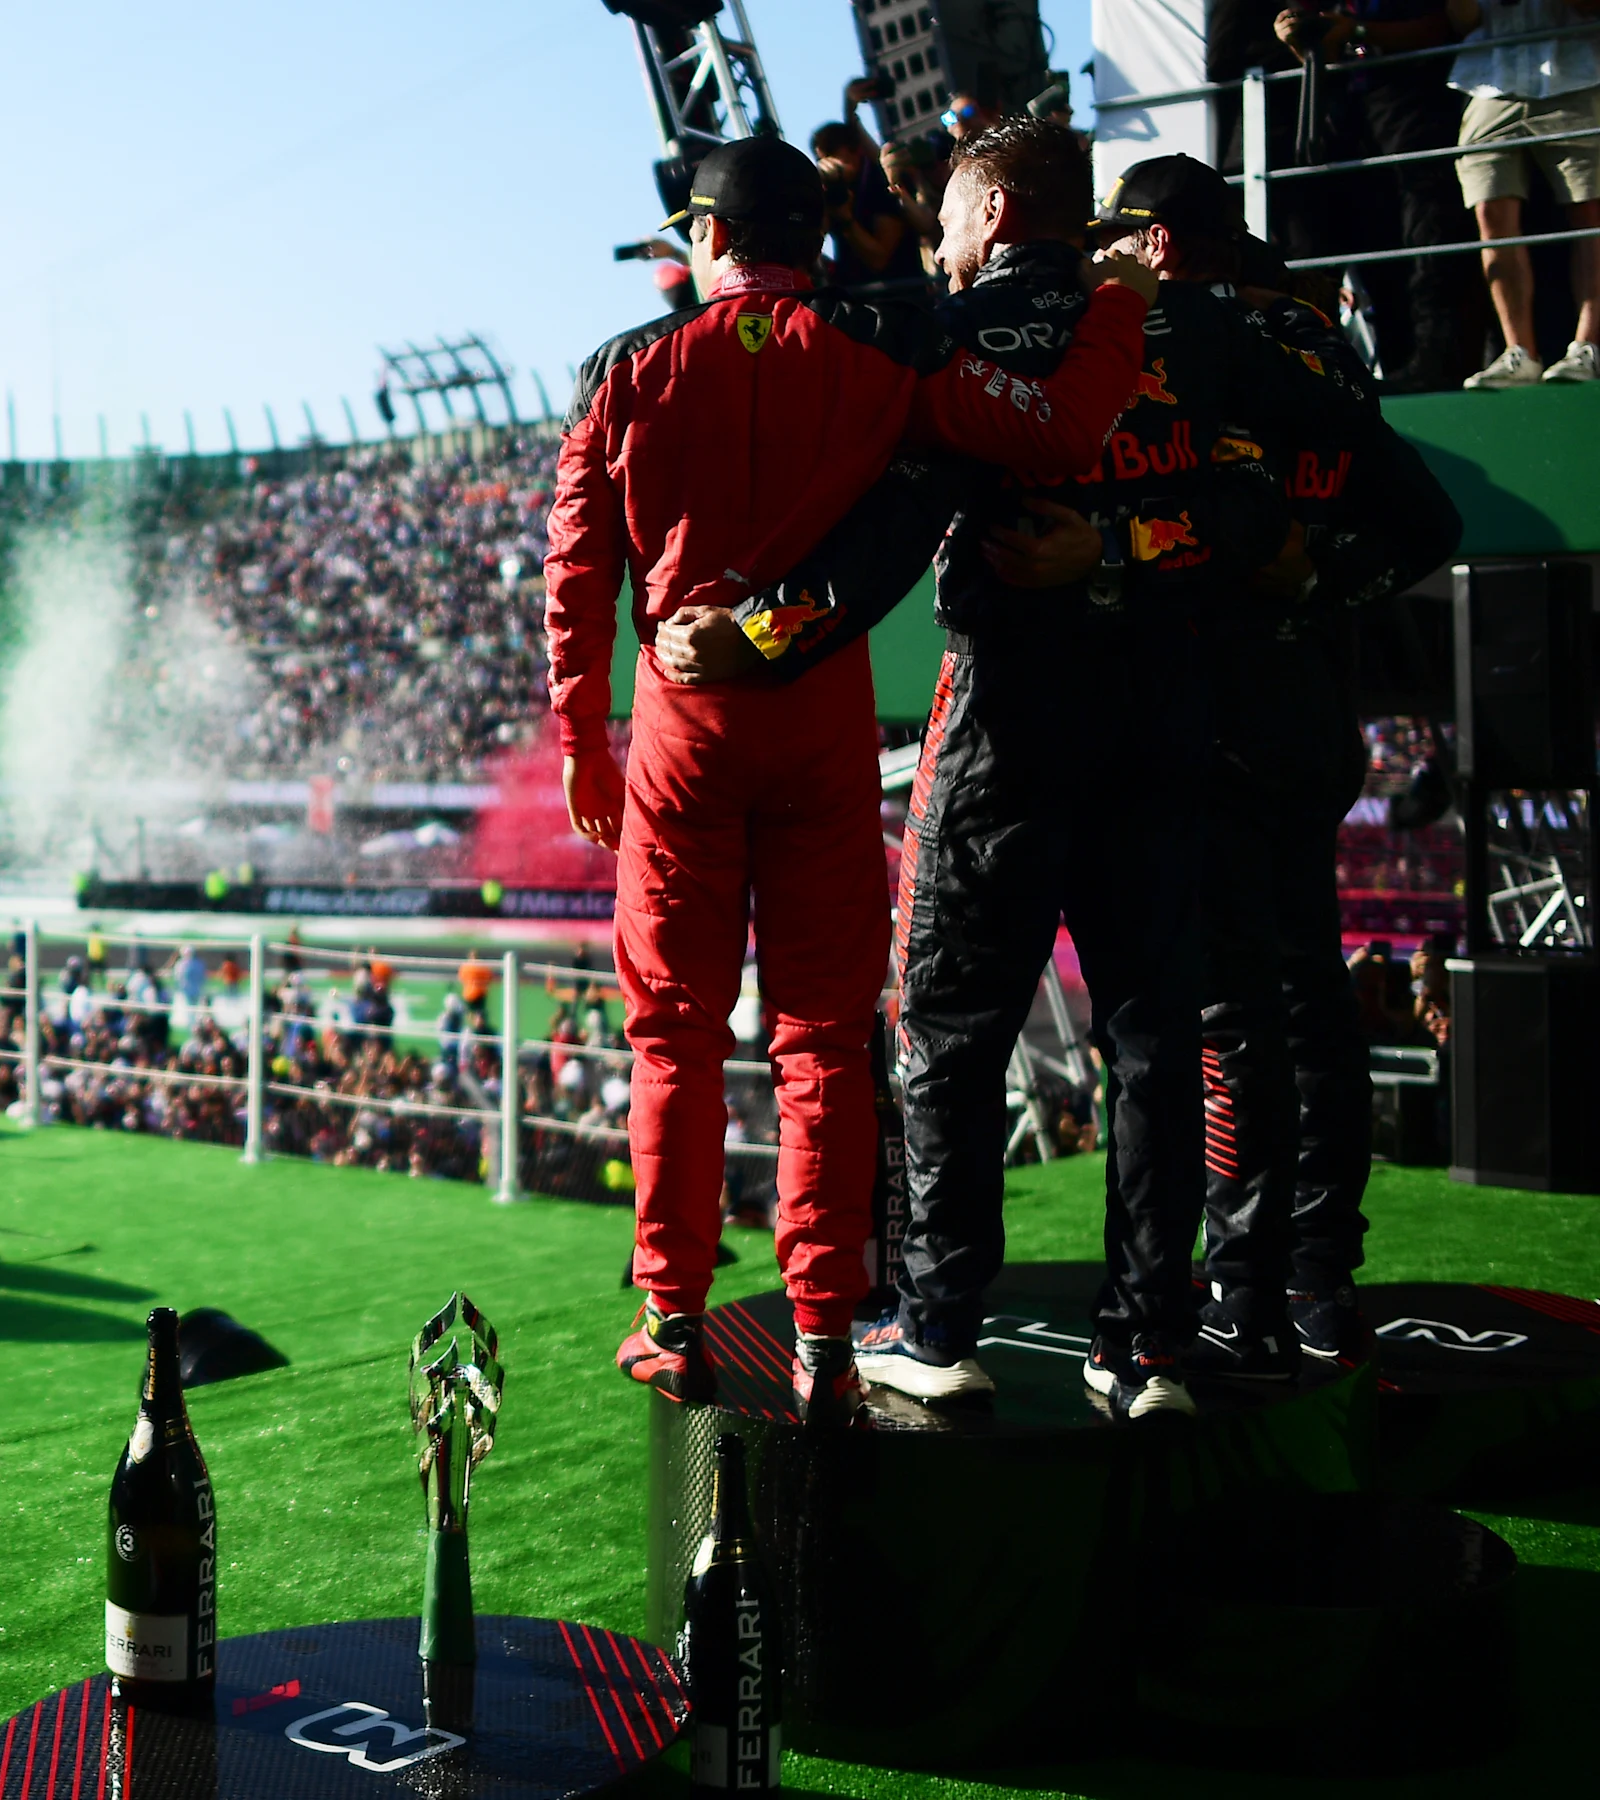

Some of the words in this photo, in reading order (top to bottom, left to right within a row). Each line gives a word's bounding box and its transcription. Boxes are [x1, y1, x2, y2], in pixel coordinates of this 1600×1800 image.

[1111, 419, 1200, 482] Bull
[122, 1533, 135, 1552] 3
[193, 1478, 216, 1680] FERRARI
[735, 1597, 763, 1791] FERRARI
